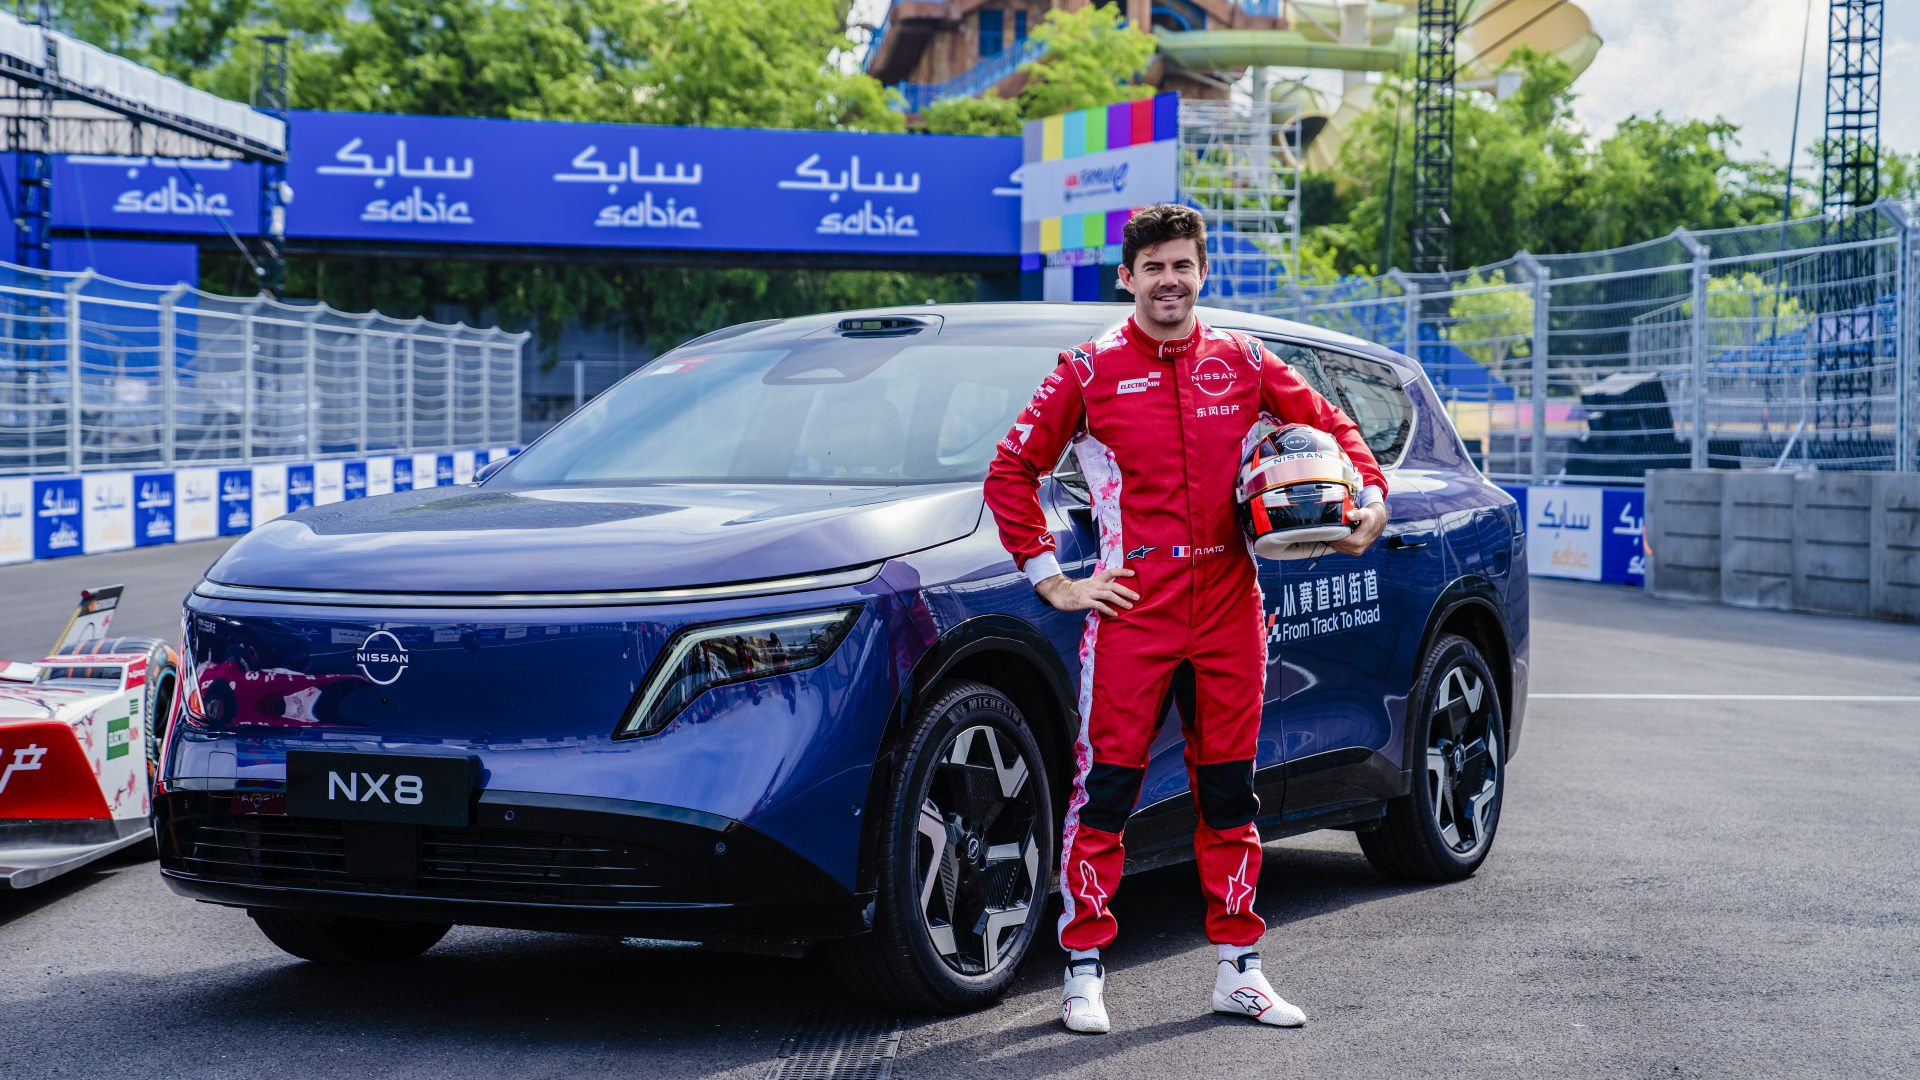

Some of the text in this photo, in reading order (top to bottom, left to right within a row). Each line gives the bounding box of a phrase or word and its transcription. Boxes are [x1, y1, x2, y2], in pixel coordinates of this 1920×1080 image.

[316, 137, 473, 190] سابك
[552, 144, 702, 195] سابك
[777, 153, 920, 203] سابك
[112, 176, 234, 216] sabic
[360, 185, 475, 224] sabic
[593, 191, 702, 229] sabic
[815, 199, 920, 237] sabic
[1120, 381, 1160, 390] ELECTROMIN
[1191, 372, 1237, 382] NISSAN
[1196, 404, 1240, 418] 东风日产
[1273, 452, 1323, 464] NISSAN
[1536, 500, 1591, 539] سابك
[1282, 569, 1379, 618] 从赛道到街道
[1282, 604, 1381, 642] From Track To Road
[356, 652, 409, 663] NISSAN
[968, 697, 1021, 723] MICHELIN
[328, 771, 424, 805] NX8
